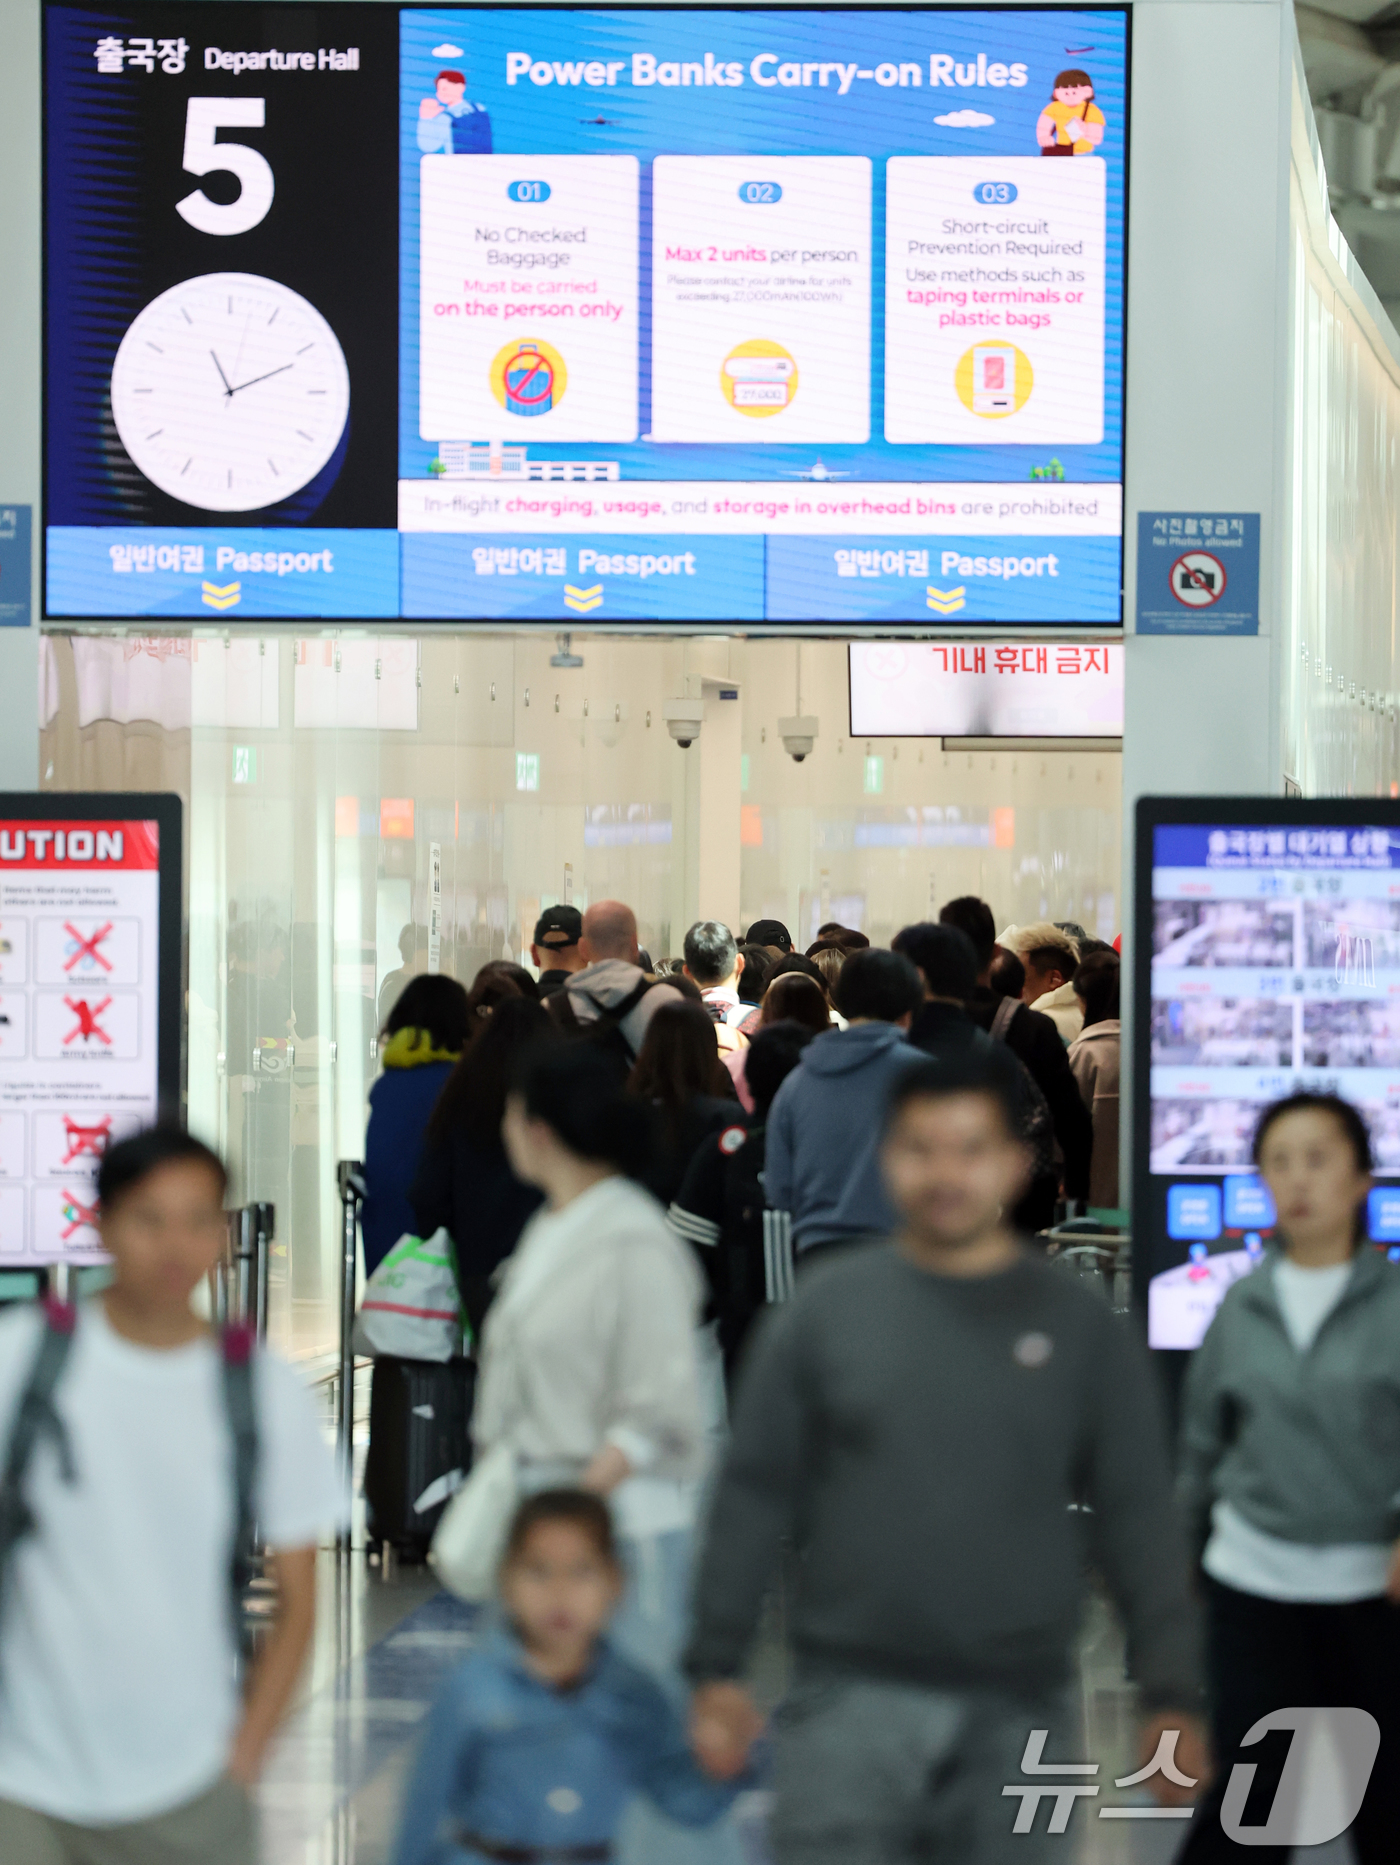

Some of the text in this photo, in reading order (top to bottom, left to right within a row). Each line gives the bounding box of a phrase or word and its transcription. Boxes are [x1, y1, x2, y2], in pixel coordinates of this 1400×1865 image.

[94, 36, 190, 74] 출국장
[204, 47, 360, 75] Departure Hall
[506, 52, 1029, 95] Power Banks Carry-on Rules
[175, 96, 275, 236] 5
[517, 181, 541, 202] 01
[746, 182, 774, 203] 02
[981, 183, 1010, 203] 03
[474, 227, 586, 243] No Checked
[941, 218, 1049, 234] Short-circuit
[486, 249, 571, 269] Baggage
[665, 245, 859, 264] Max 2 units per person
[907, 239, 1083, 258] Prevention Required
[906, 267, 1085, 282] Use methods such as
[463, 279, 598, 294] Must be carried
[906, 287, 1084, 306] taping terminals or
[434, 299, 623, 322] on the person only
[939, 310, 1051, 329] plastic bags
[425, 496, 1098, 519] In-flight charging, usage, and storage in overhead bins are prohibited
[1152, 536, 1167, 546] No
[109, 545, 204, 573] 일반여권
[216, 547, 333, 576] Passport
[472, 547, 567, 576] 일반여권
[579, 549, 696, 579] Passport
[834, 550, 929, 577] 일반여권
[941, 551, 1059, 580] Passport
[932, 647, 1109, 674] 기내 휴대 금지
[0, 829, 124, 861] UTION
